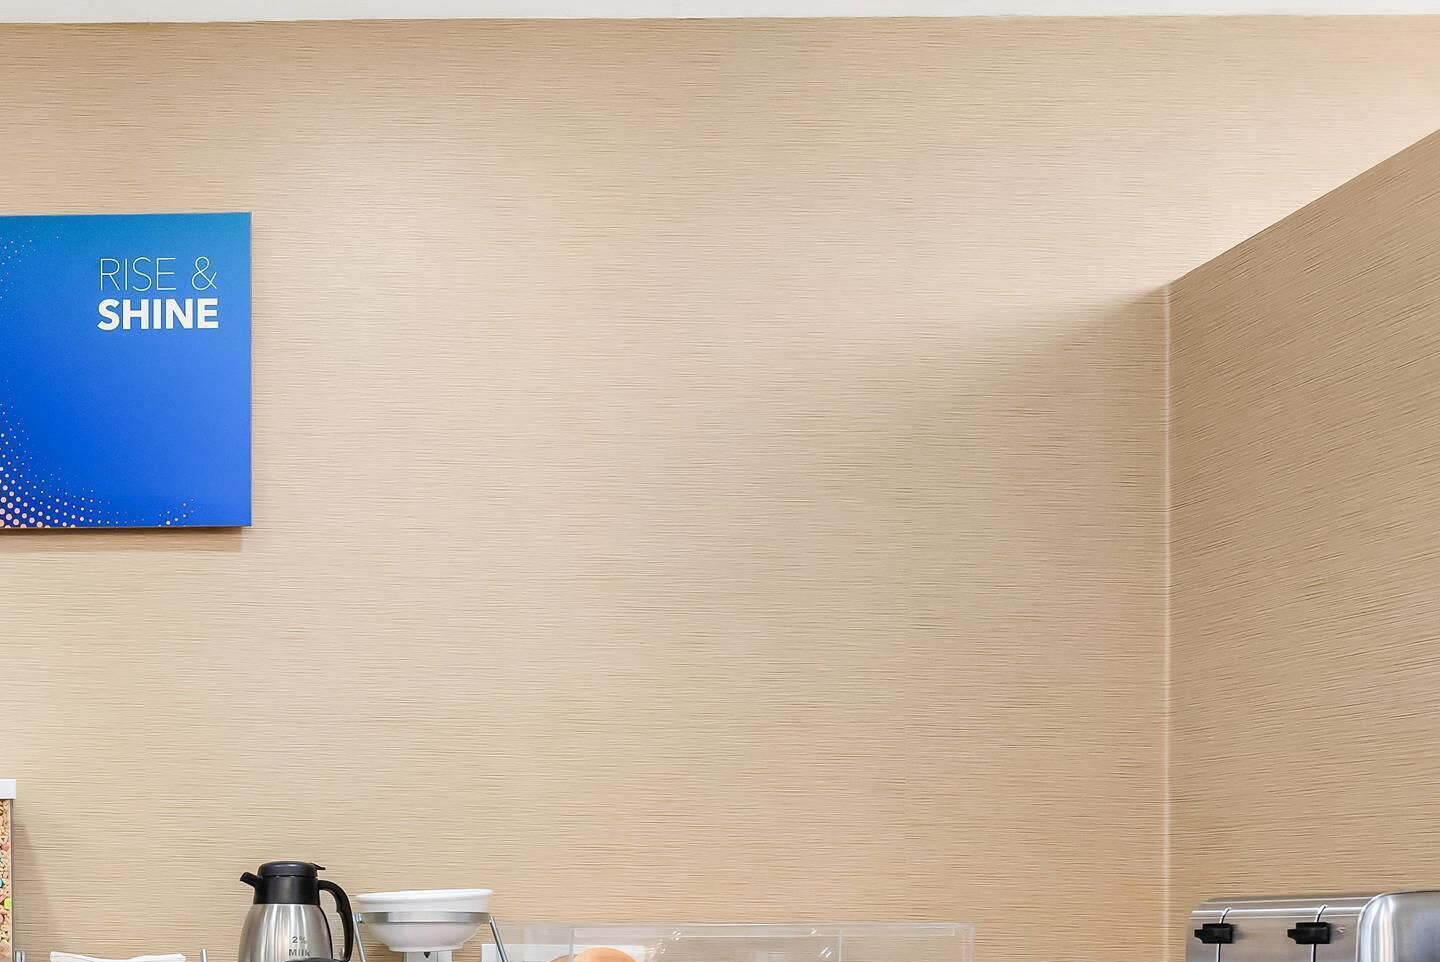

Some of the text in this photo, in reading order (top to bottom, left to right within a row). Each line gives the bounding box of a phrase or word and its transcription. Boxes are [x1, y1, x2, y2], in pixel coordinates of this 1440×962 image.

[99, 256, 218, 291] RISE &
[97, 298, 219, 331] SHINE
[292, 936, 306, 944] 2%
[288, 949, 311, 957] Milk
